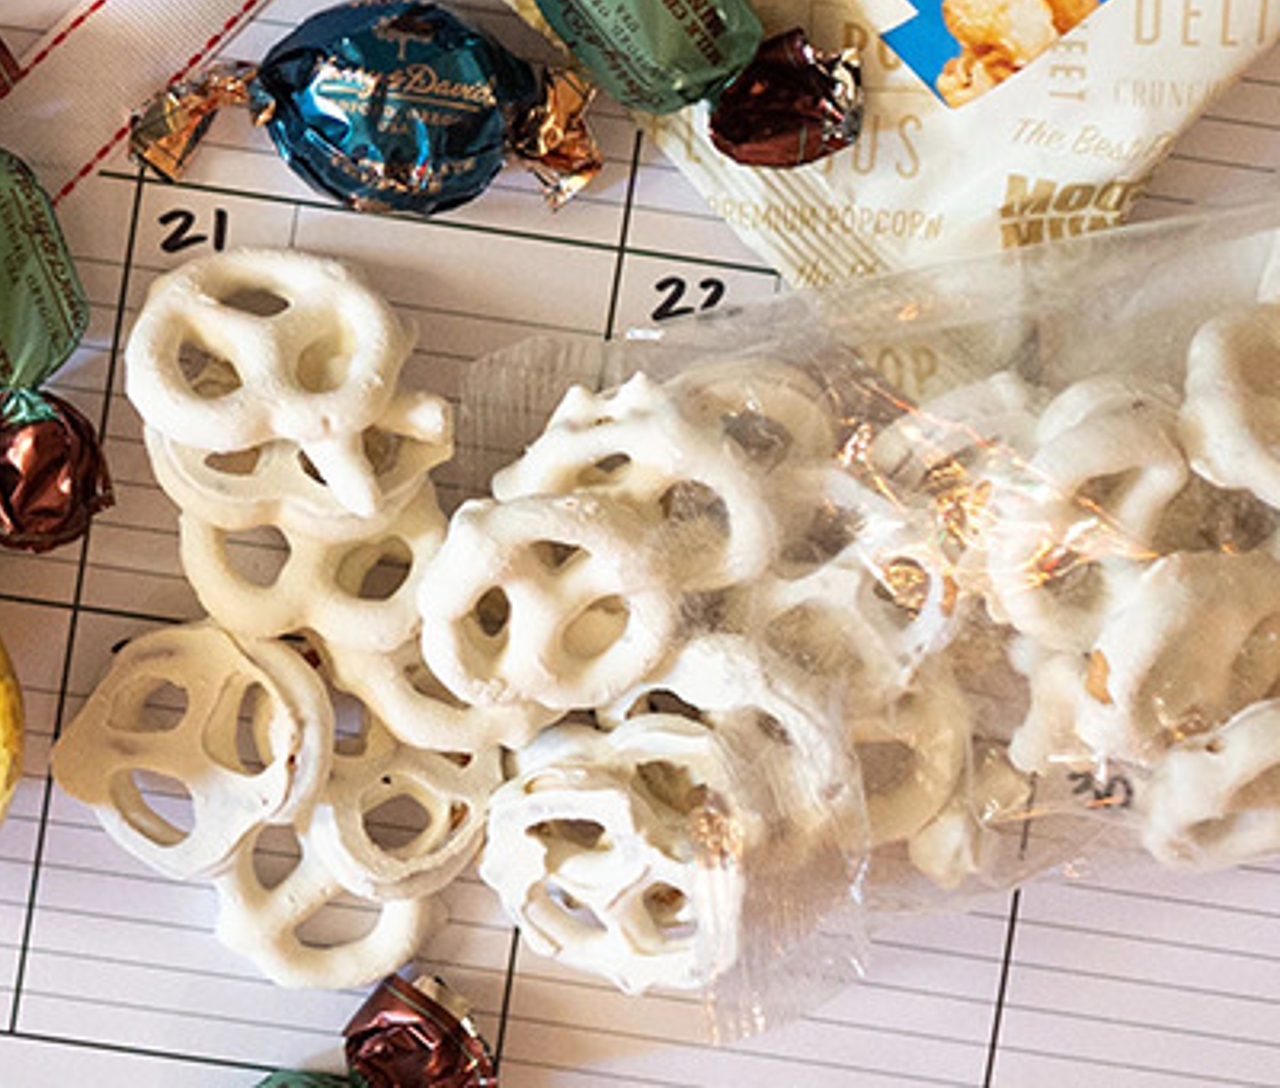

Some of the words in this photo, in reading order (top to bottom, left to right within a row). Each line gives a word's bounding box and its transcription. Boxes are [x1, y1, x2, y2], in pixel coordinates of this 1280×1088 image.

[1011, 116, 1064, 146] The
[157, 206, 229, 255] 21
[652, 275, 733, 321] 22
